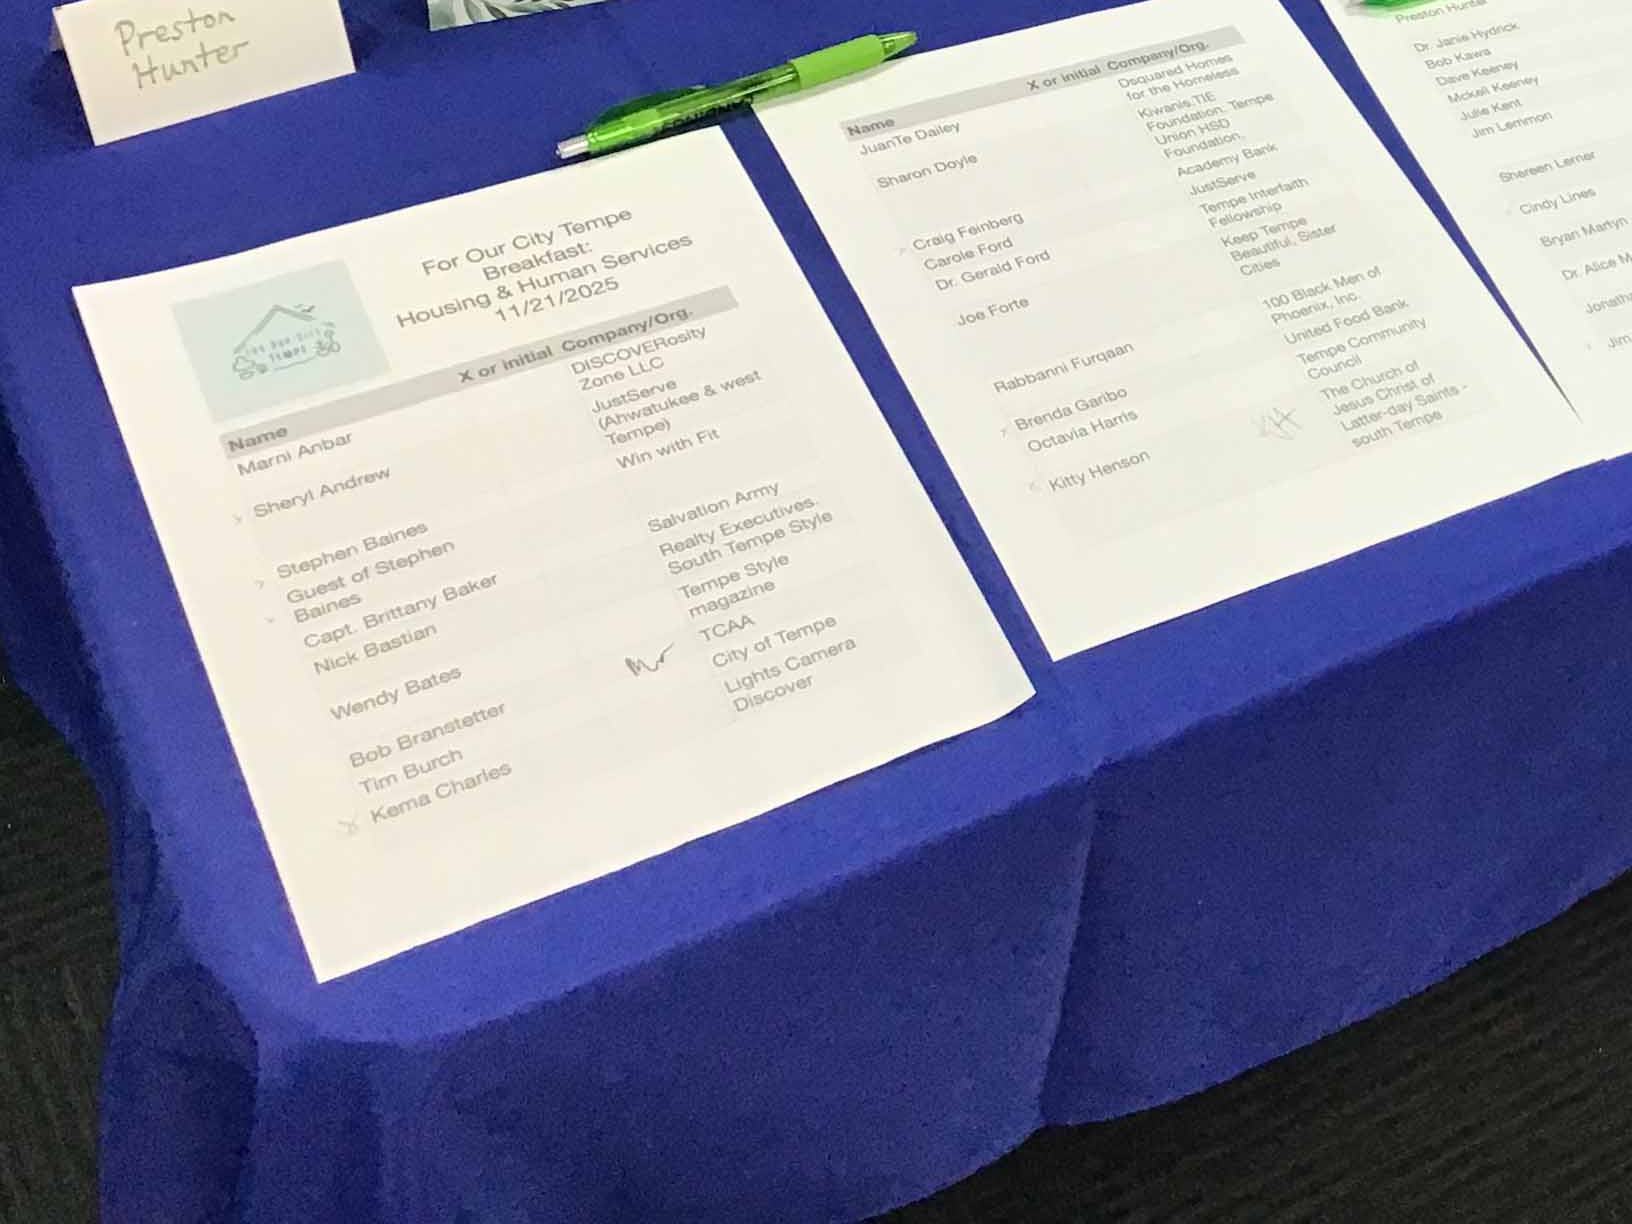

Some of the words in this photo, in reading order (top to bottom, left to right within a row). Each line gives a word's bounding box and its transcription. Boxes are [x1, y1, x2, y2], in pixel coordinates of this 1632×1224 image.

[114, 7, 236, 57] Preston
[131, 40, 250, 90] Hunter
[847, 116, 896, 137] Name
[915, 120, 961, 142] Dailey
[877, 164, 933, 190] Sharon
[934, 152, 978, 175] Doyle
[1177, 156, 1241, 178] Academy
[1242, 143, 1279, 160] Bank
[1519, 197, 1558, 216] Cindy
[1560, 187, 1597, 204] Lines
[421, 250, 462, 276] For
[466, 241, 508, 266] Our
[512, 227, 555, 256] City
[559, 206, 633, 242] Tempe
[913, 230, 956, 252] Craig
[924, 249, 975, 271] Carole
[978, 237, 1014, 256] Ford
[1540, 229, 1581, 248] Bryan
[396, 289, 492, 329] Housing
[495, 282, 513, 300] &
[517, 260, 597, 296] Human
[602, 234, 693, 270] Services
[1585, 255, 1617, 275] Alice
[494, 275, 620, 323] 11/21/2025
[956, 309, 986, 327] Joe
[988, 296, 1030, 318] Forte
[477, 362, 498, 379] or
[502, 345, 554, 372] initial
[562, 306, 694, 353] Company/Org.
[1283, 322, 1333, 346] United
[1334, 309, 1370, 331] Food
[1372, 298, 1409, 318] Bank
[1608, 332, 1632, 349] Jim
[591, 378, 678, 415] JustServe
[1015, 404, 1073, 432] Brenda
[227, 425, 288, 454] Name
[237, 451, 292, 477] Marni
[299, 431, 353, 459] Anbar
[616, 449, 654, 470] Win
[657, 435, 694, 458] with
[696, 428, 720, 446] Fit
[1027, 426, 1089, 454] Octavia
[1048, 469, 1086, 492] Kitty
[1089, 450, 1151, 479] Henson
[253, 489, 315, 519] Sheryl
[320, 466, 391, 497] Andrew
[648, 497, 730, 533] Salvation
[735, 480, 780, 507] Army
[276, 543, 359, 581] Stephen
[364, 520, 429, 551] Baines
[286, 576, 347, 605] Guest
[352, 566, 370, 585] of
[375, 539, 456, 577] Stephen
[678, 569, 741, 601] Tempe
[744, 550, 790, 580] Style
[294, 592, 362, 624] Baines
[304, 623, 358, 650] Capt.
[364, 597, 439, 630] Brittany
[443, 573, 499, 602] Baker
[688, 579, 776, 620] magazine
[313, 646, 359, 676] Nick
[364, 622, 438, 659] Bastian
[699, 614, 756, 643] TCAA
[724, 663, 783, 694] Lights
[785, 636, 857, 672] Camera
[330, 688, 399, 722] Wendy
[405, 667, 462, 696] Bates
[734, 673, 815, 713] Discover
[349, 743, 392, 769] Bob
[397, 701, 507, 750] Branstetter
[359, 770, 398, 795] Tim
[403, 747, 464, 781] Burch
[435, 762, 513, 799] Charles
